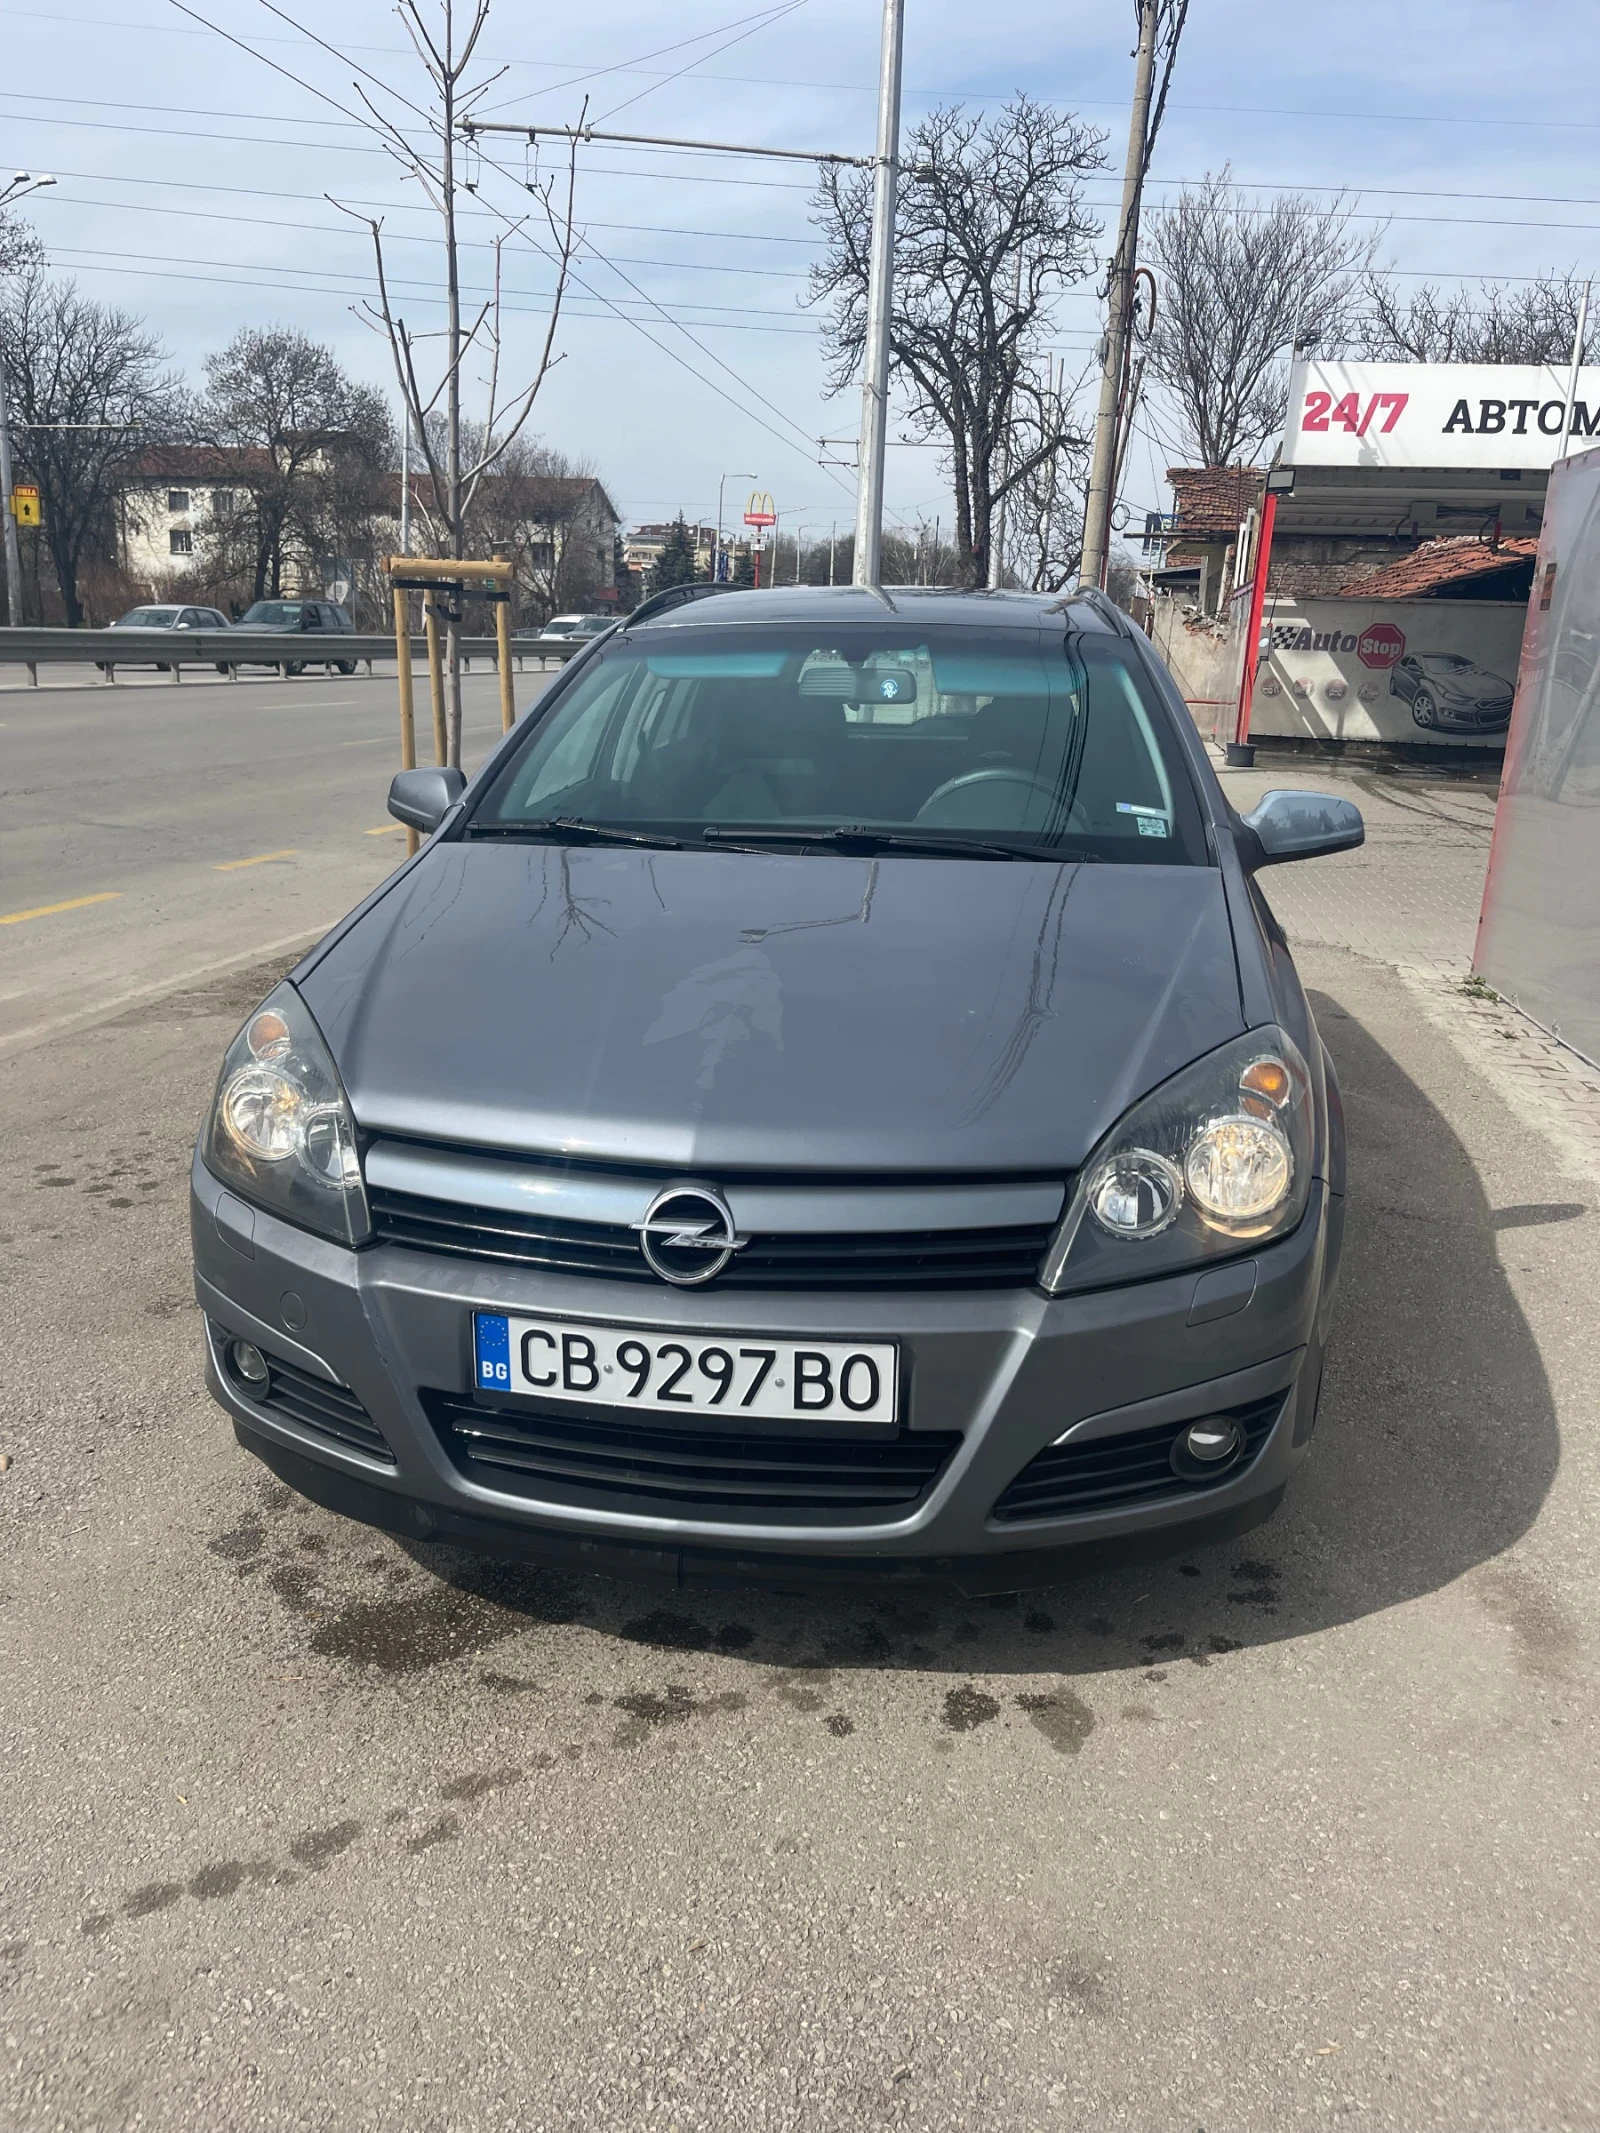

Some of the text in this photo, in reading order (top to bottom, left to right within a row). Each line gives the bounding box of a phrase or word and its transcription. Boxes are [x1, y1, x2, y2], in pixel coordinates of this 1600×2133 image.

[1302, 391, 1409, 437] 24/7
[1292, 627, 1400, 658] Auto Stop
[482, 1360, 507, 1380] BG
[520, 1329, 599, 1392] CB
[616, 1340, 776, 1406] 9297
